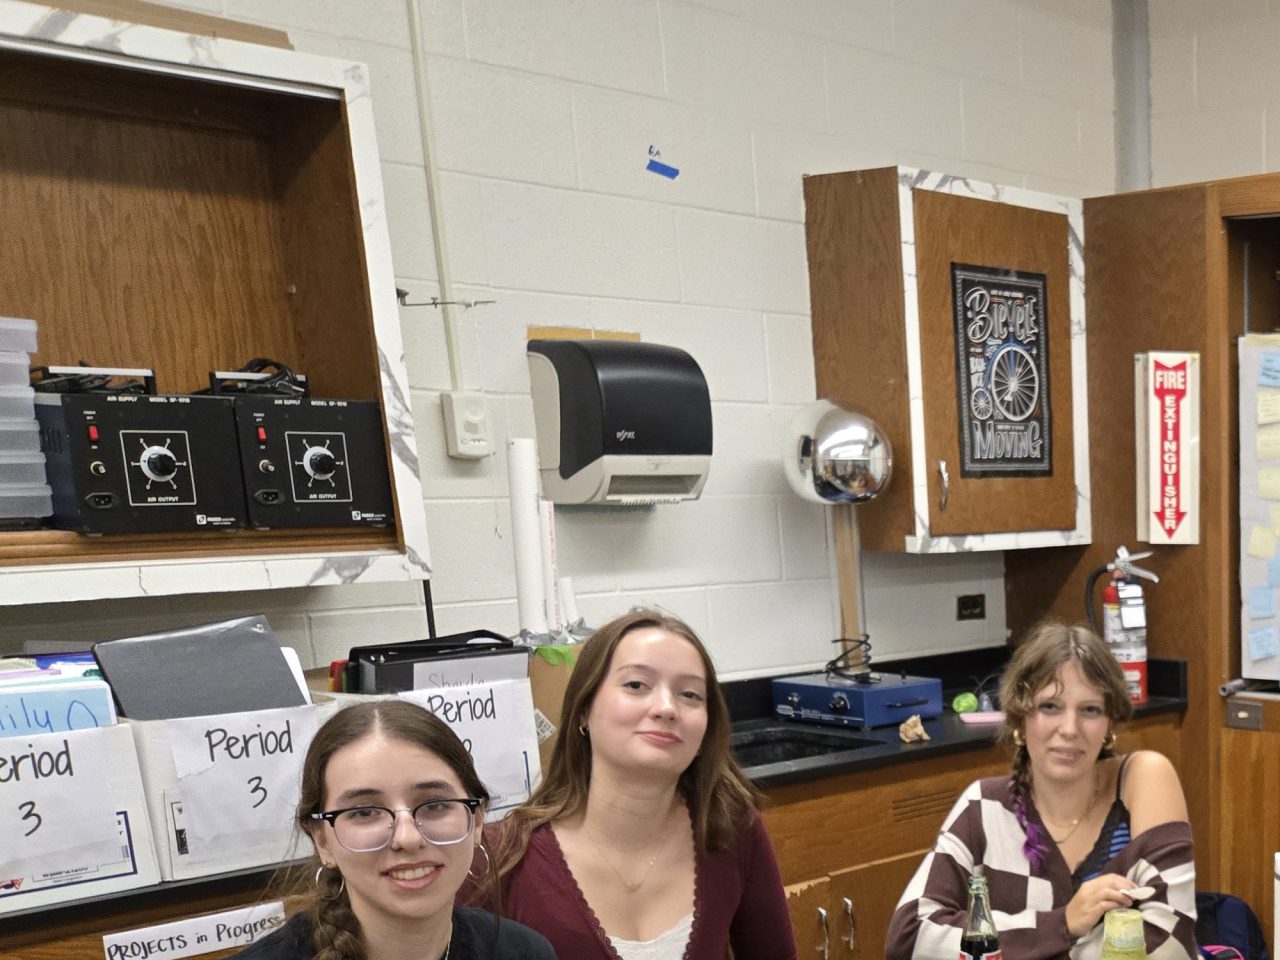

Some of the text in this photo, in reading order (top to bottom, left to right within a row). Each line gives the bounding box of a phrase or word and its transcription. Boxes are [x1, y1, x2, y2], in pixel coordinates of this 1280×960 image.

[1155, 370, 1185, 389] FIRE
[1164, 395, 1177, 529] EXTINGUISHER
[427, 688, 496, 723] Period
[205, 719, 294, 762] Period
[0, 739, 74, 784] eriod
[247, 775, 269, 809] 3
[18, 800, 42, 837] 3
[195, 931, 208, 945] in
[216, 915, 286, 943] Progress
